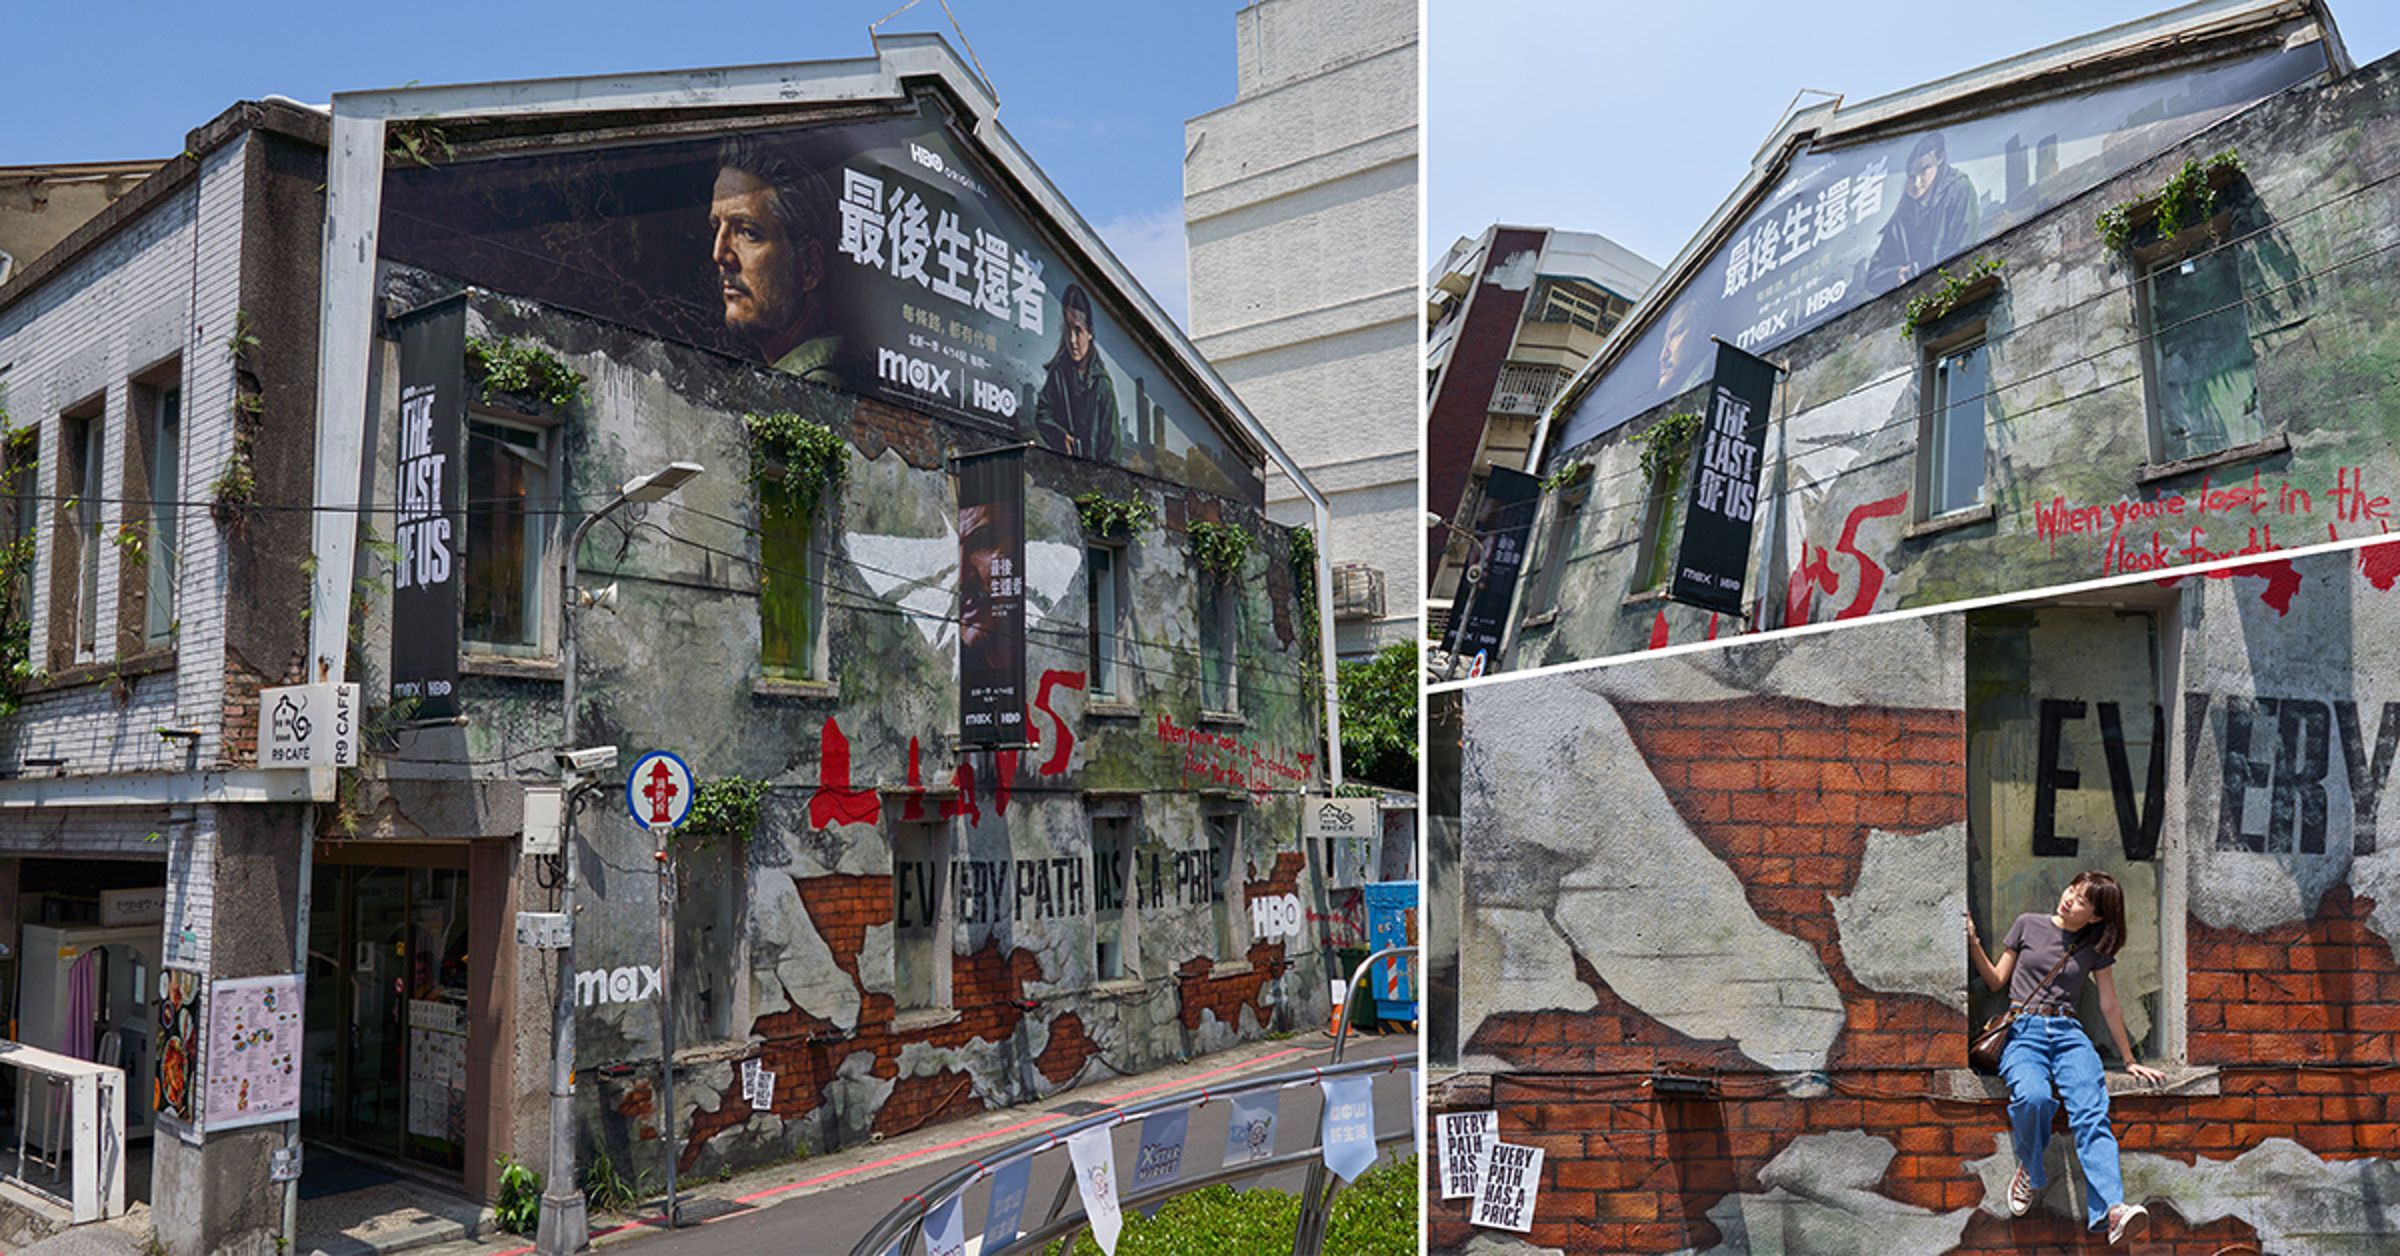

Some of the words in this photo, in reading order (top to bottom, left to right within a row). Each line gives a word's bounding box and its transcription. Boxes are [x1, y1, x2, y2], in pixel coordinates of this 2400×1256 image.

[911, 143, 944, 181] HBO
[1721, 155, 1888, 299] 最後生還者
[838, 167, 1046, 335] 最後生還者
[1735, 308, 1789, 348] max
[1806, 280, 1847, 316] HBO
[878, 347, 951, 399] max
[973, 379, 1017, 417] HBO
[401, 393, 435, 463] THE
[1715, 395, 1750, 441] THE
[1704, 429, 1757, 481] LAST
[398, 454, 446, 525] LAST
[1697, 468, 1727, 512] OF
[1724, 478, 1755, 522] US
[2034, 496, 2101, 542] When
[2199, 466, 2268, 515] lost
[2279, 480, 2312, 515] in
[2326, 466, 2392, 524] the
[396, 523, 416, 589] OF
[416, 517, 451, 586] US
[2117, 532, 2171, 573] look
[336, 685, 350, 736] CAFÉ
[336, 743, 348, 764] R9
[1015, 857, 1085, 920] PATH
[1251, 893, 1300, 939] HBO
[574, 965, 663, 1006] max
[1446, 1113, 1488, 1135] EVERY
[1448, 1135, 1482, 1155] PATH
[1450, 1155, 1477, 1175] HAS
[1487, 1164, 1524, 1187] PATH
[1491, 1144, 1534, 1169] EVERY
[1451, 1173, 1478, 1195] PRI
[1484, 1184, 1513, 1205] HAS
[1515, 1187, 1525, 1208] A
[1481, 1203, 1522, 1227] PRICE
